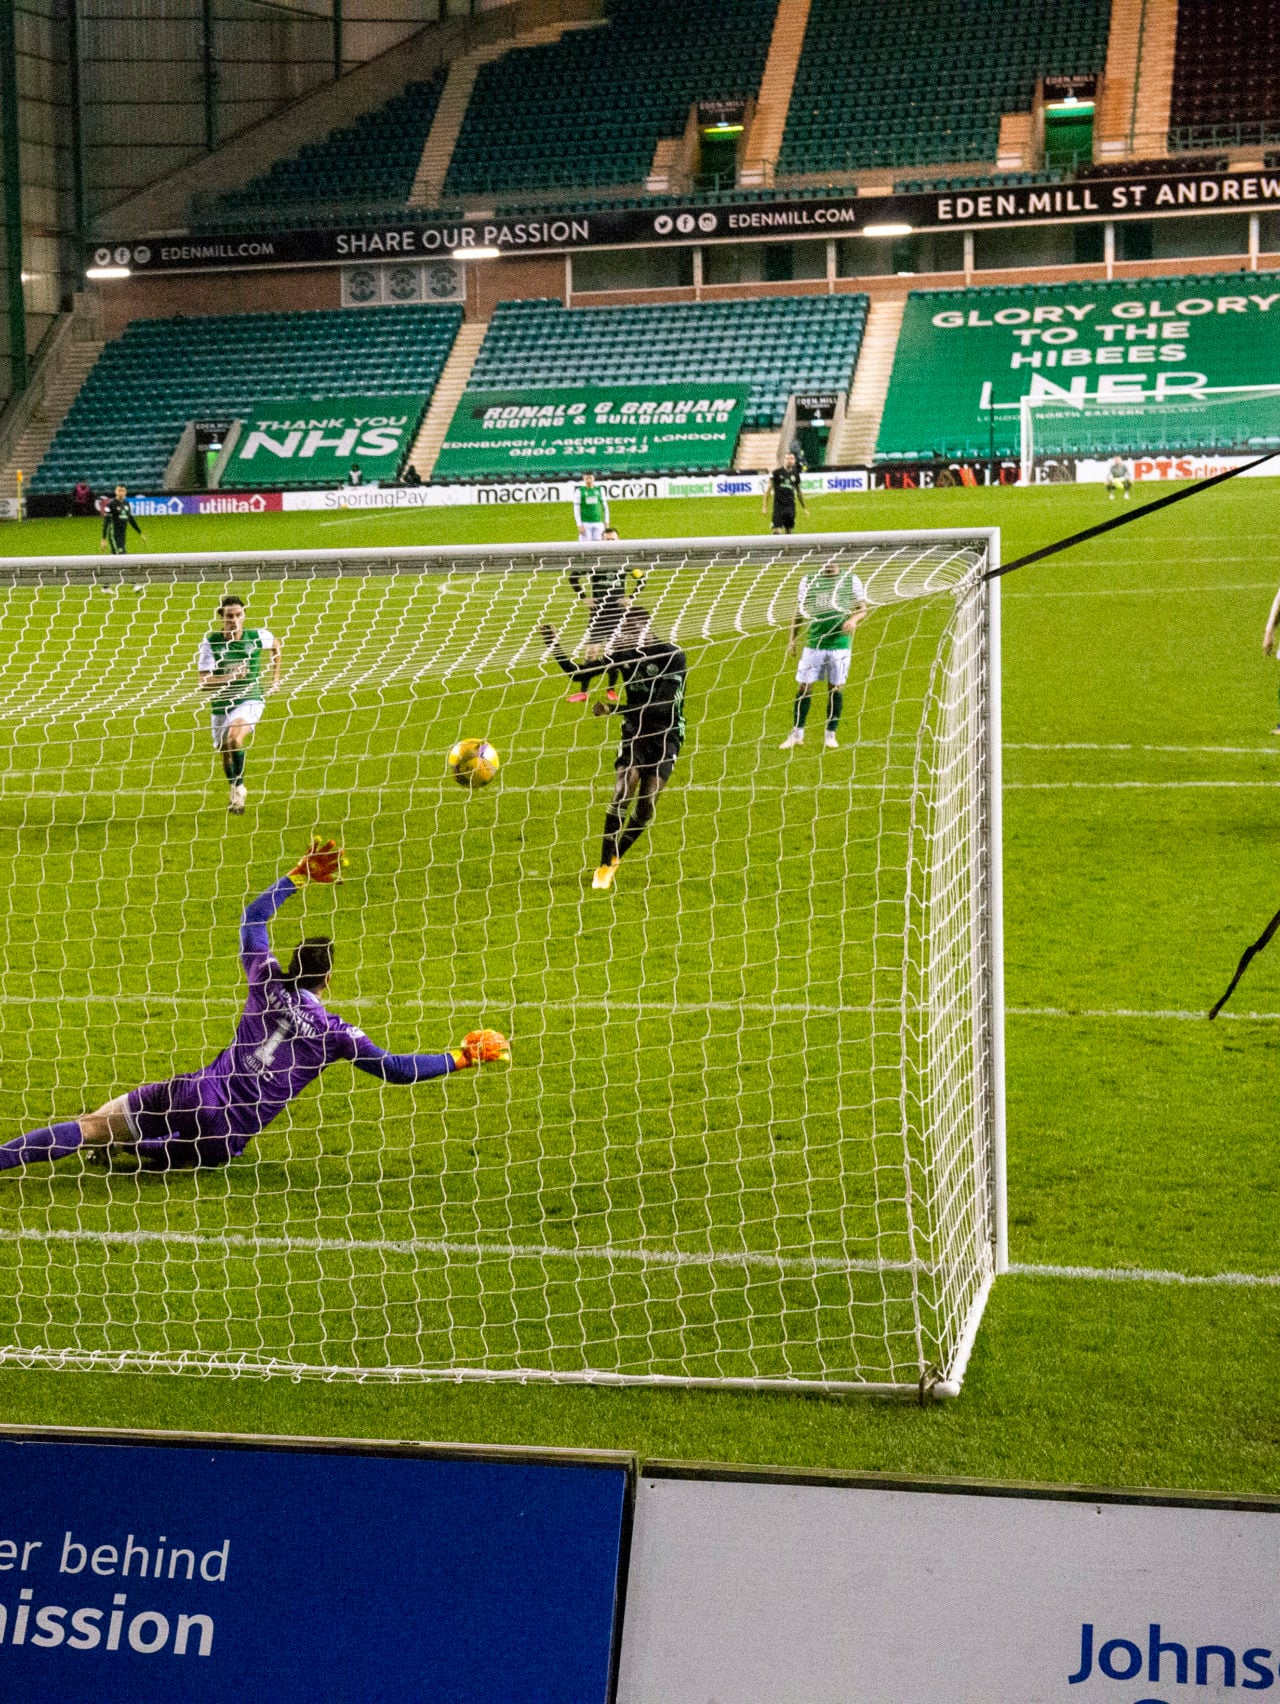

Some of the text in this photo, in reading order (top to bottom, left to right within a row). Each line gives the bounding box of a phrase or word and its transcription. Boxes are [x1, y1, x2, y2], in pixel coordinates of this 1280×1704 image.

[937, 190, 1098, 220] EDEN.MILL
[1112, 185, 1146, 208] ST
[728, 207, 856, 229] EDENMILL.COM
[336, 220, 590, 255] SHARE OUR PASSION
[160, 243, 275, 261] EDENMILL.COM
[932, 293, 1279, 328] GLORY GLORY
[1012, 322, 1191, 346] TO THE
[1010, 344, 1188, 369] HIBEES
[979, 371, 1208, 411] LNER
[484, 403, 588, 419] RONALD
[620, 399, 737, 415] GRAHAM
[256, 416, 407, 431] THANK YOU
[482, 416, 565, 429] ROOFING
[595, 413, 687, 425] BUILDING
[695, 412, 729, 423] LTD
[238, 428, 403, 460] NHS
[442, 432, 727, 449] EDINBURGH ABERDEEN LONDON
[1134, 461, 1194, 480] PTS
[716, 479, 752, 495] signs
[827, 475, 863, 490] signs
[129, 494, 249, 516] tilita utilita
[324, 490, 428, 508] SportingPay
[477, 486, 560, 503] macron
[253, 1018, 293, 1067] 1
[58, 1531, 231, 1582] behind
[1067, 1623, 1280, 1690] Johns
